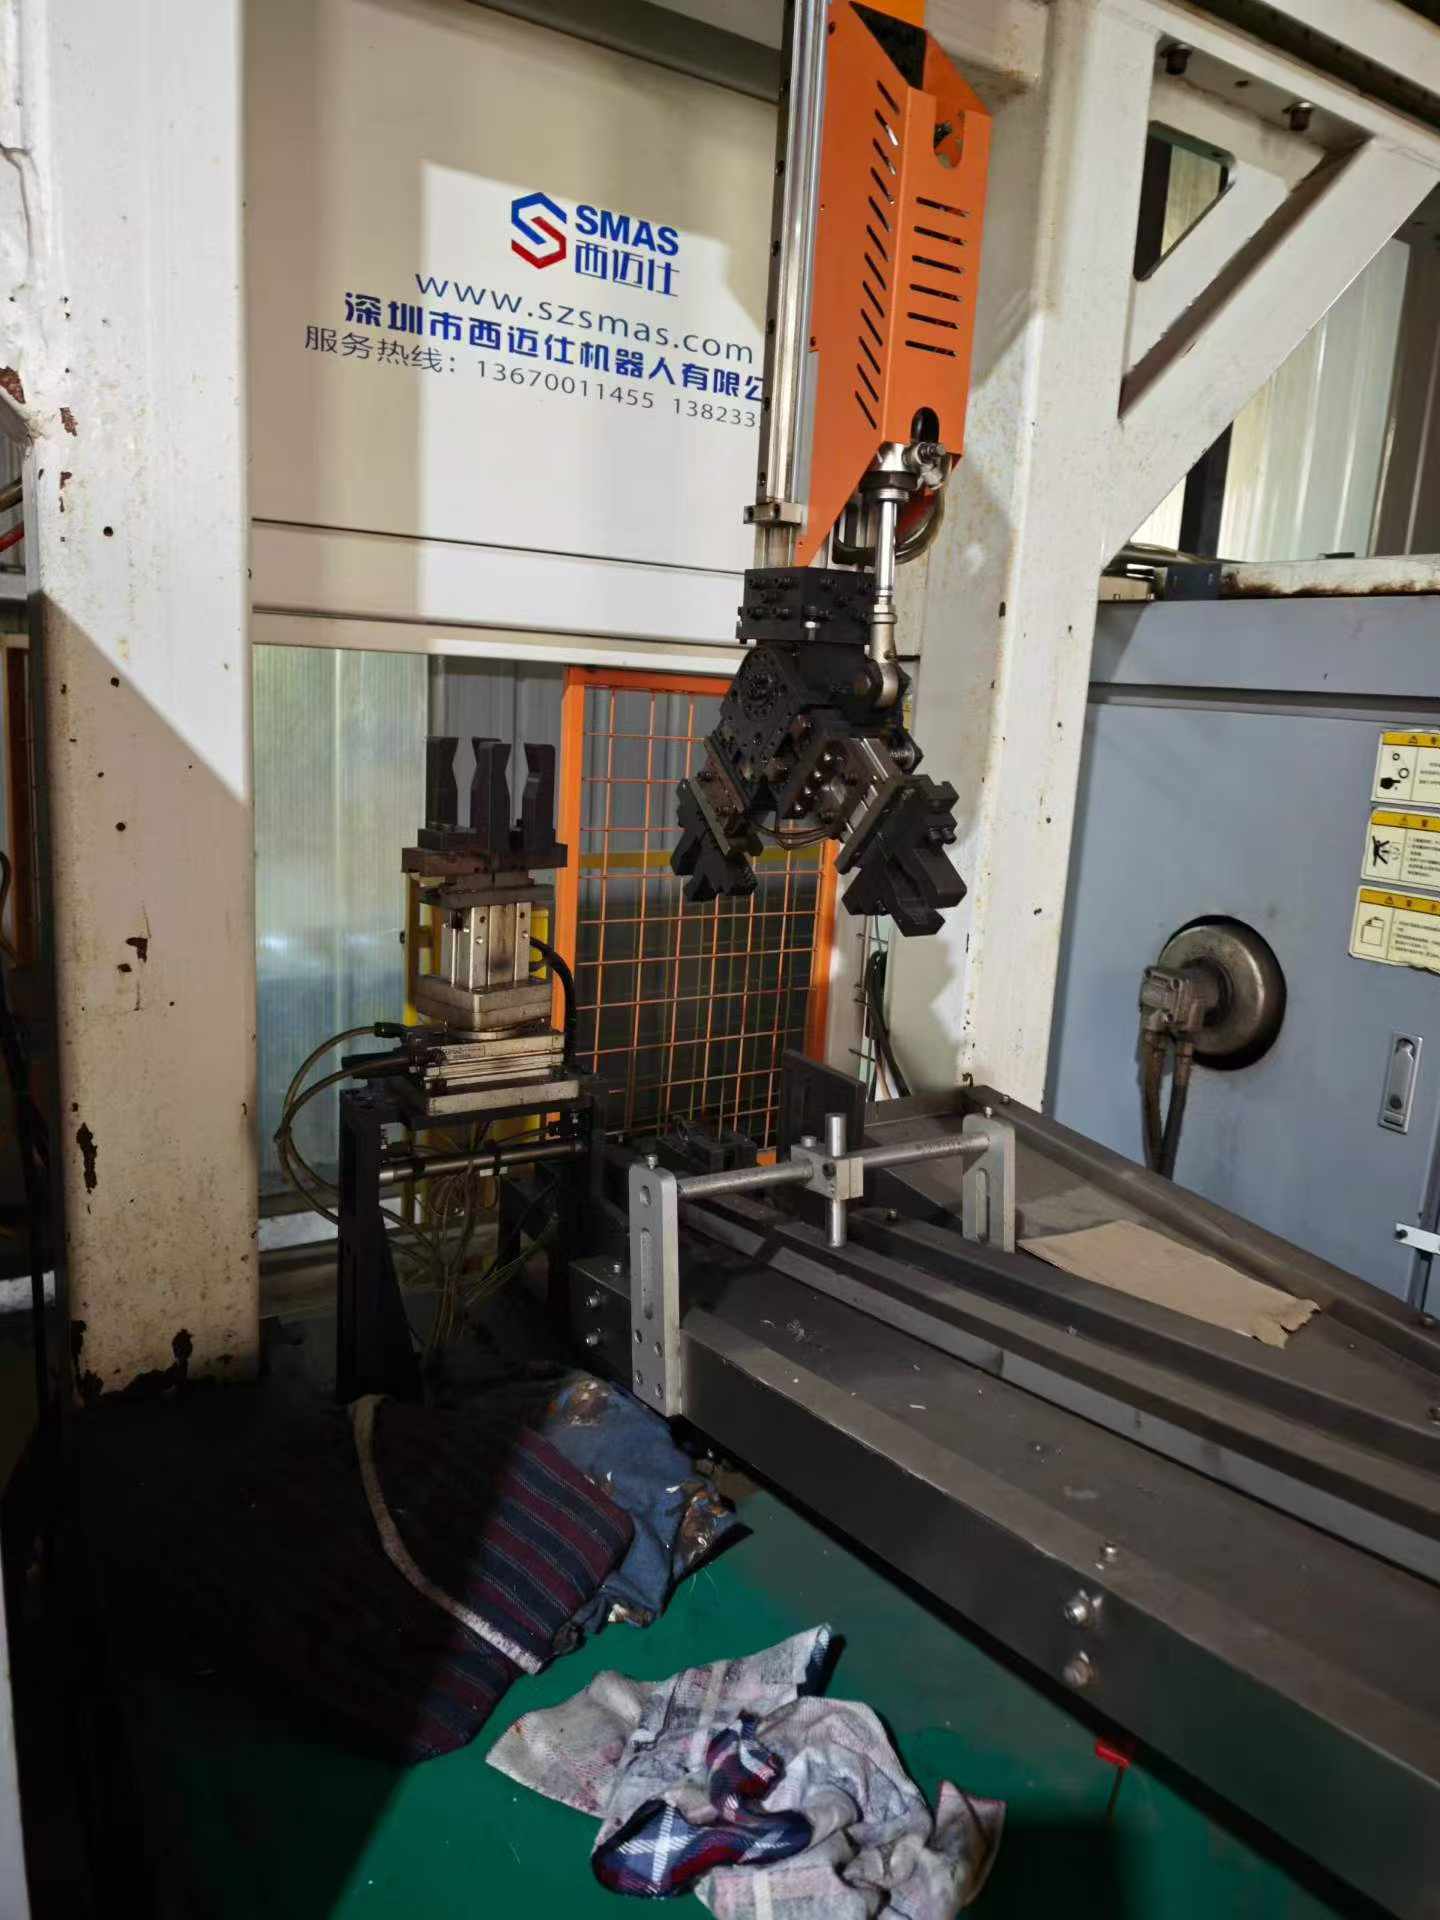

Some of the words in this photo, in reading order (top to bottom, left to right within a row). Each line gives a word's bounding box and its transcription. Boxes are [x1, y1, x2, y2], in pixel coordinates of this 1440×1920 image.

[575, 204, 679, 256] SMAS
[575, 240, 680, 297] 西迈仕
[415, 273, 753, 364] www.szsmas.com
[477, 360, 654, 409] 13670011455
[673, 397, 760, 430] 138233
